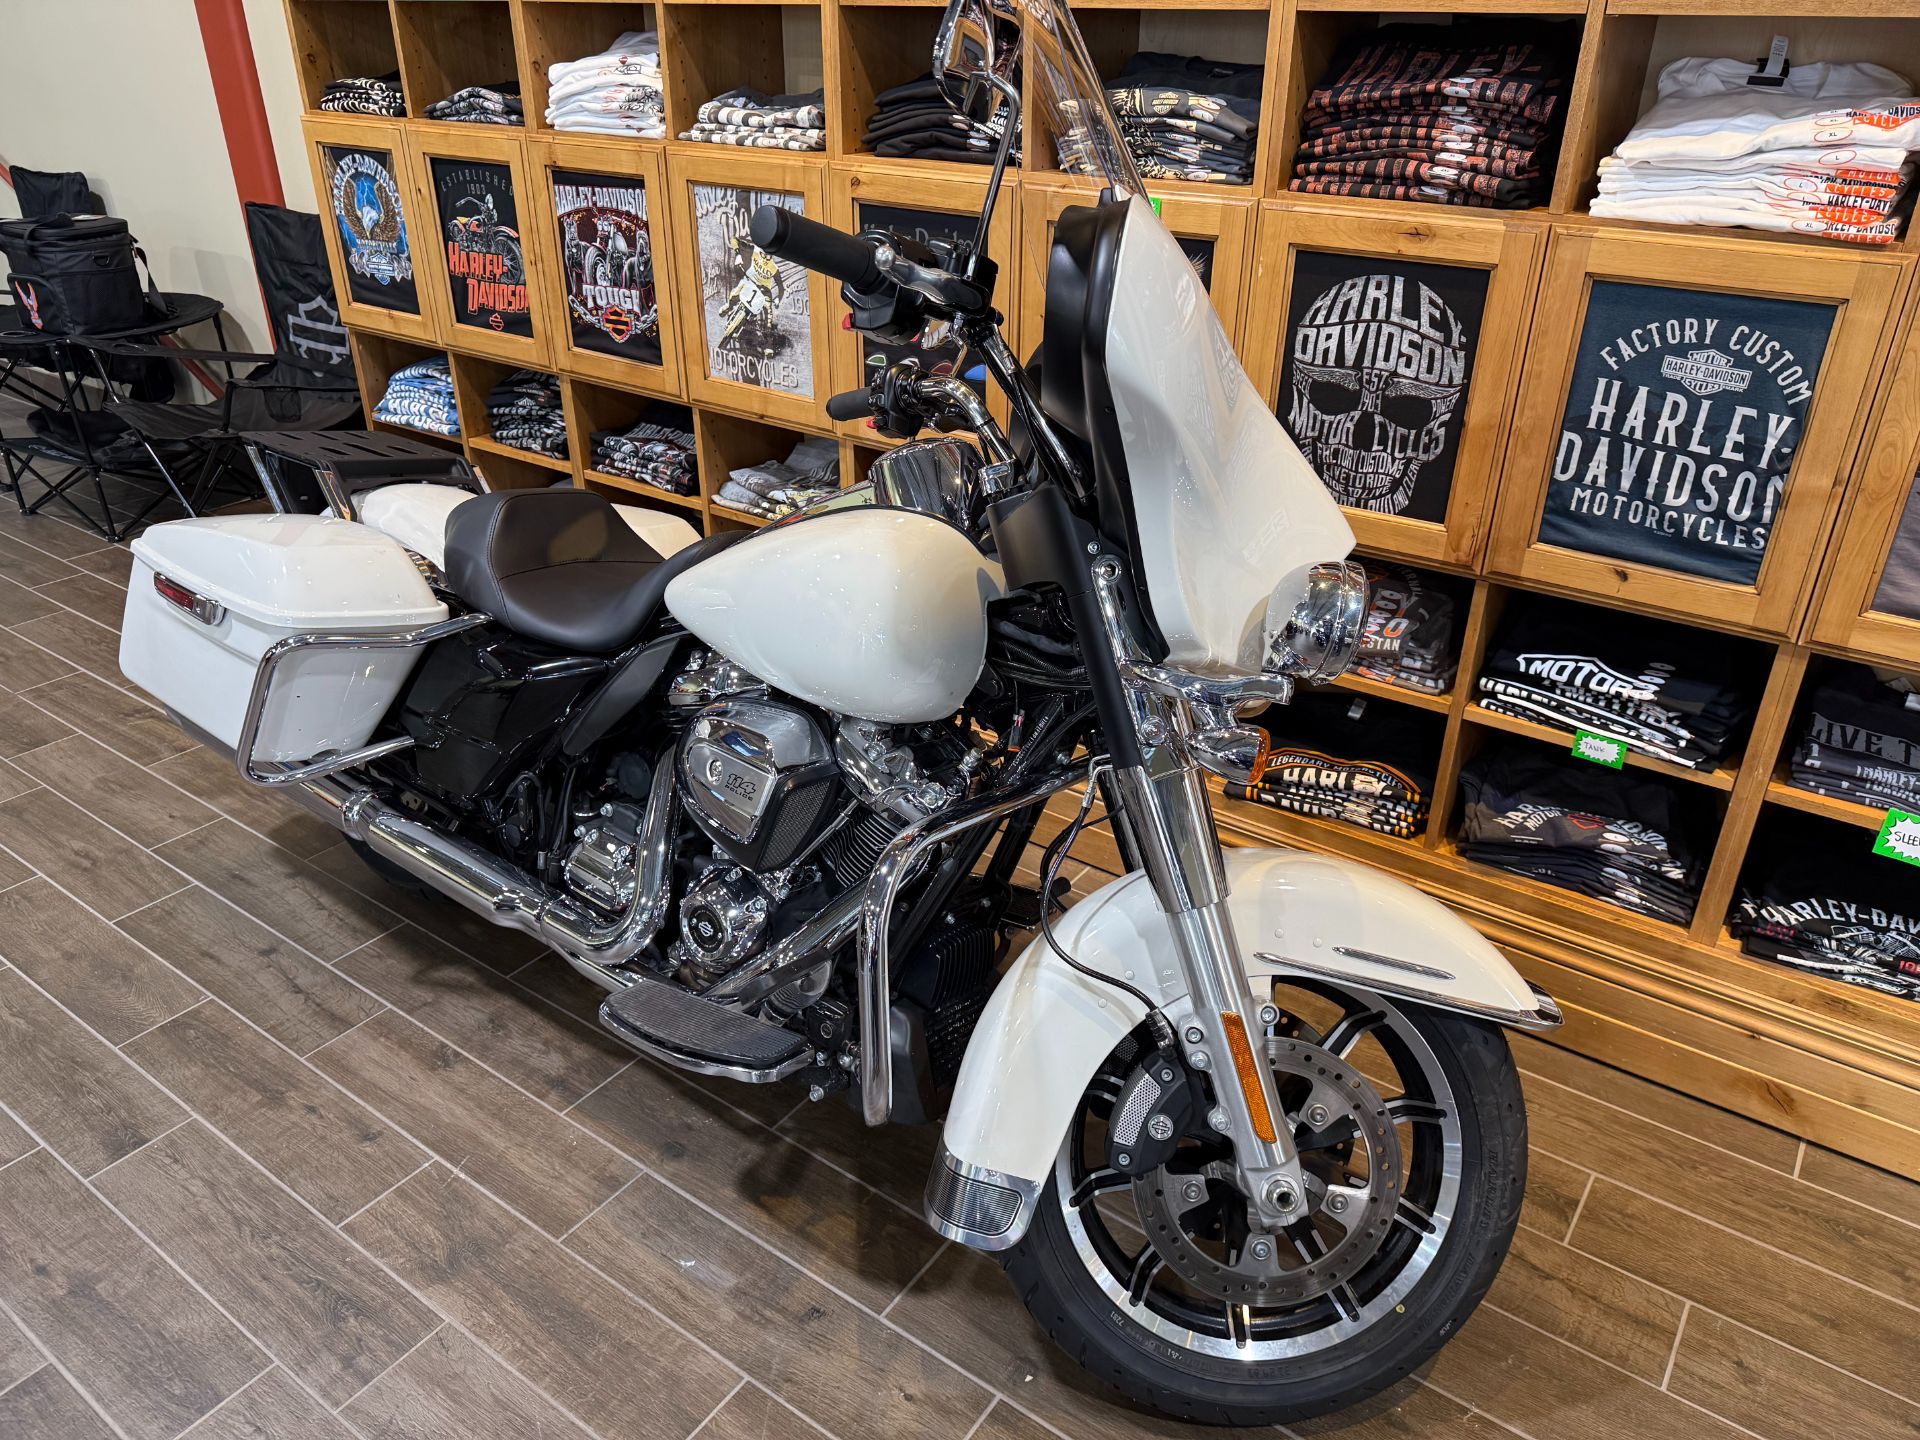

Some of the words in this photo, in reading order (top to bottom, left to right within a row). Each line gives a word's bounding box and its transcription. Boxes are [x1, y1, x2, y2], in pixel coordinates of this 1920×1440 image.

[466, 183, 487, 195] 1903
[447, 240, 509, 282] HARLEY-
[746, 289, 758, 304] 1
[1300, 274, 1467, 349] HARLEY-
[1294, 322, 1466, 384] DAVIDSON
[1600, 318, 1720, 371] FACTORY
[1729, 325, 1813, 406] CUSTOM
[1691, 351, 1728, 367] MOTOR
[1665, 359, 1747, 385] HARLEY-DAVIDSON
[1685, 379, 1719, 393] CYCLES
[1358, 388, 1383, 413] 1903
[1430, 392, 1461, 421] POWER
[1288, 385, 1362, 448] MOTOR
[1372, 413, 1452, 462] CYCLES
[1585, 377, 1796, 470] HARLEY-
[1316, 441, 1357, 471] FACTORY
[1358, 448, 1407, 478] CUSTOMS
[1321, 471, 1345, 493] RIDE
[1347, 486, 1362, 498] TO
[1361, 485, 1391, 499] LIVE
[1323, 463, 1347, 484] LIVE
[1349, 471, 1365, 488] TO
[1366, 473, 1393, 489] RIDE
[1392, 485, 1410, 514] AND
[1403, 459, 1423, 496] CLEAR
[1569, 487, 1766, 550] MOTORCYCLES
[1583, 741, 1605, 754] TANK
[1808, 713, 1883, 757] LIVE
[1271, 754, 1329, 768] LEGENDARY
[724, 784, 754, 801] POLICE
[726, 773, 756, 794] 114
